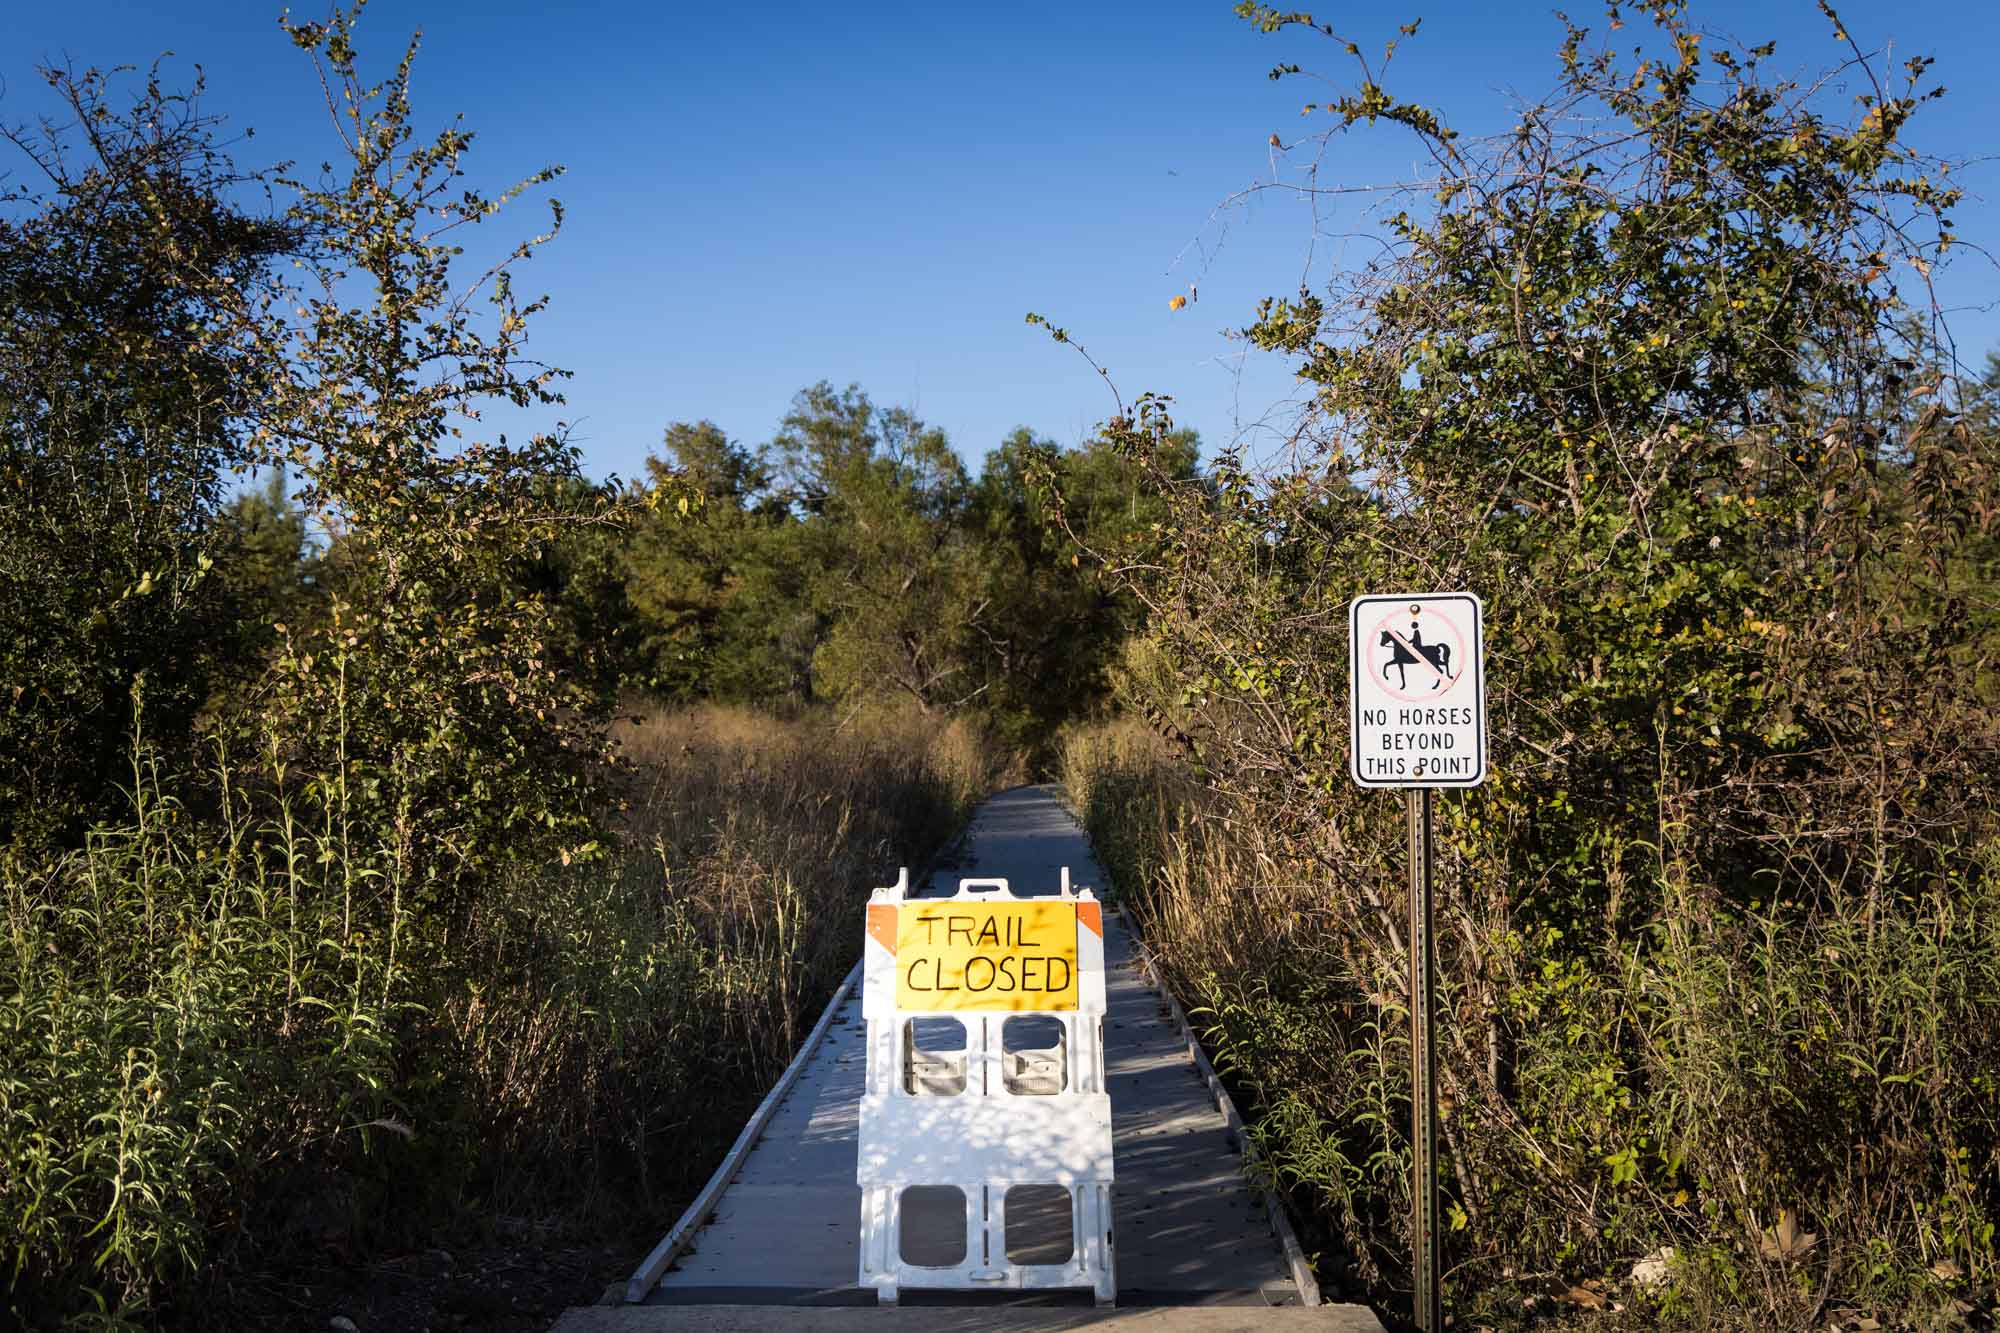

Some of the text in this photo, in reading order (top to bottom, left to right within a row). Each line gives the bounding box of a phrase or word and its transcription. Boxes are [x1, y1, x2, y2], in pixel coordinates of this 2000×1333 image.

[1363, 708, 1472, 726] NO HORSES
[1382, 733, 1454, 750] BEYOND
[1366, 757, 1472, 775] THIS POINT
[916, 915, 1041, 947] TRAIL
[907, 956, 1071, 993] CLOSED
